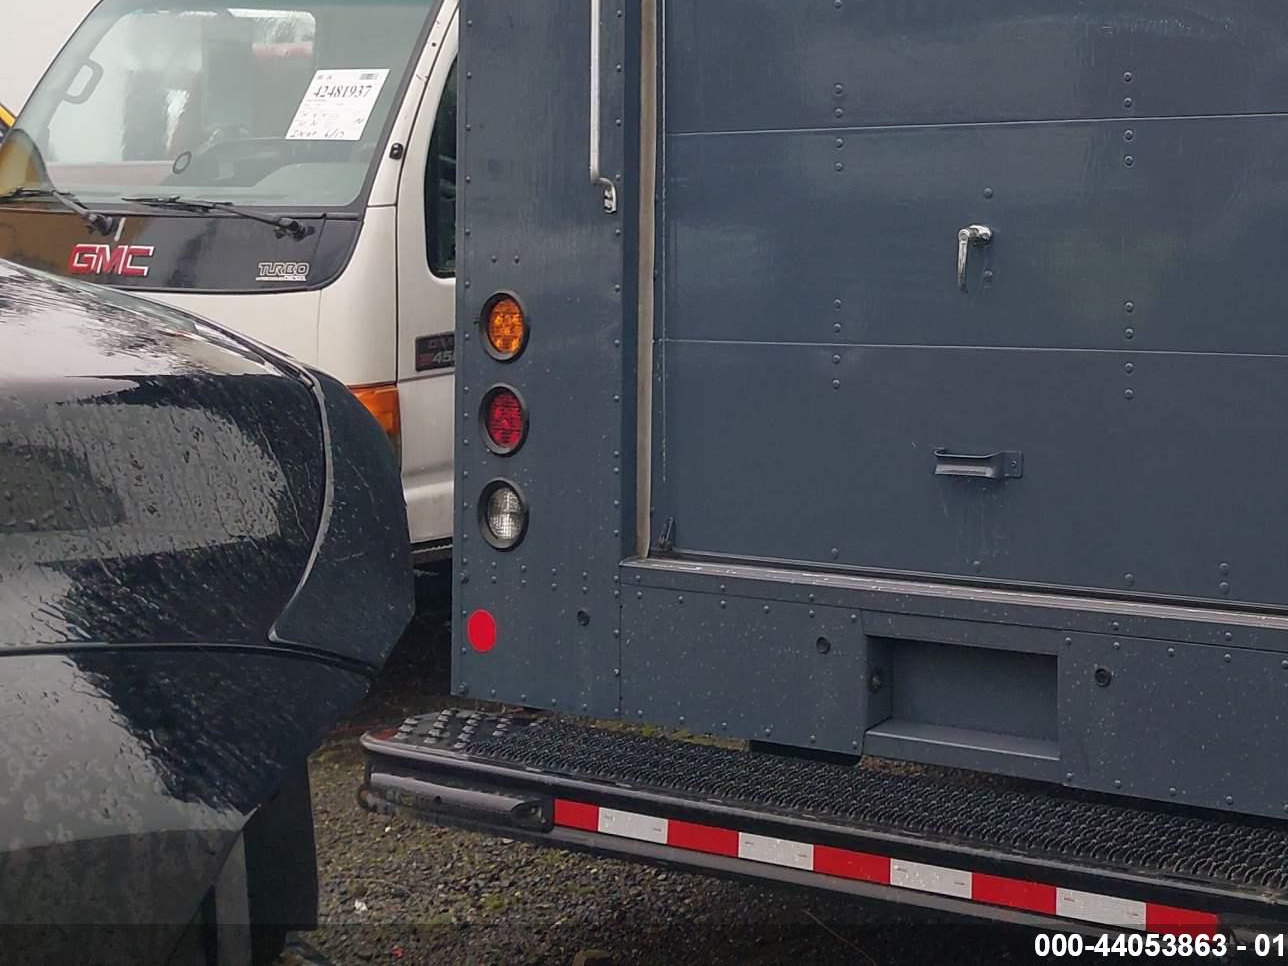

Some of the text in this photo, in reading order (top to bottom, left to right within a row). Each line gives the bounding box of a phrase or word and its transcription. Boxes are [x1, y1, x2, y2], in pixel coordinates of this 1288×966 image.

[313, 85, 373, 98] 42481937
[68, 243, 155, 277] GMC
[258, 261, 310, 276] TURBO
